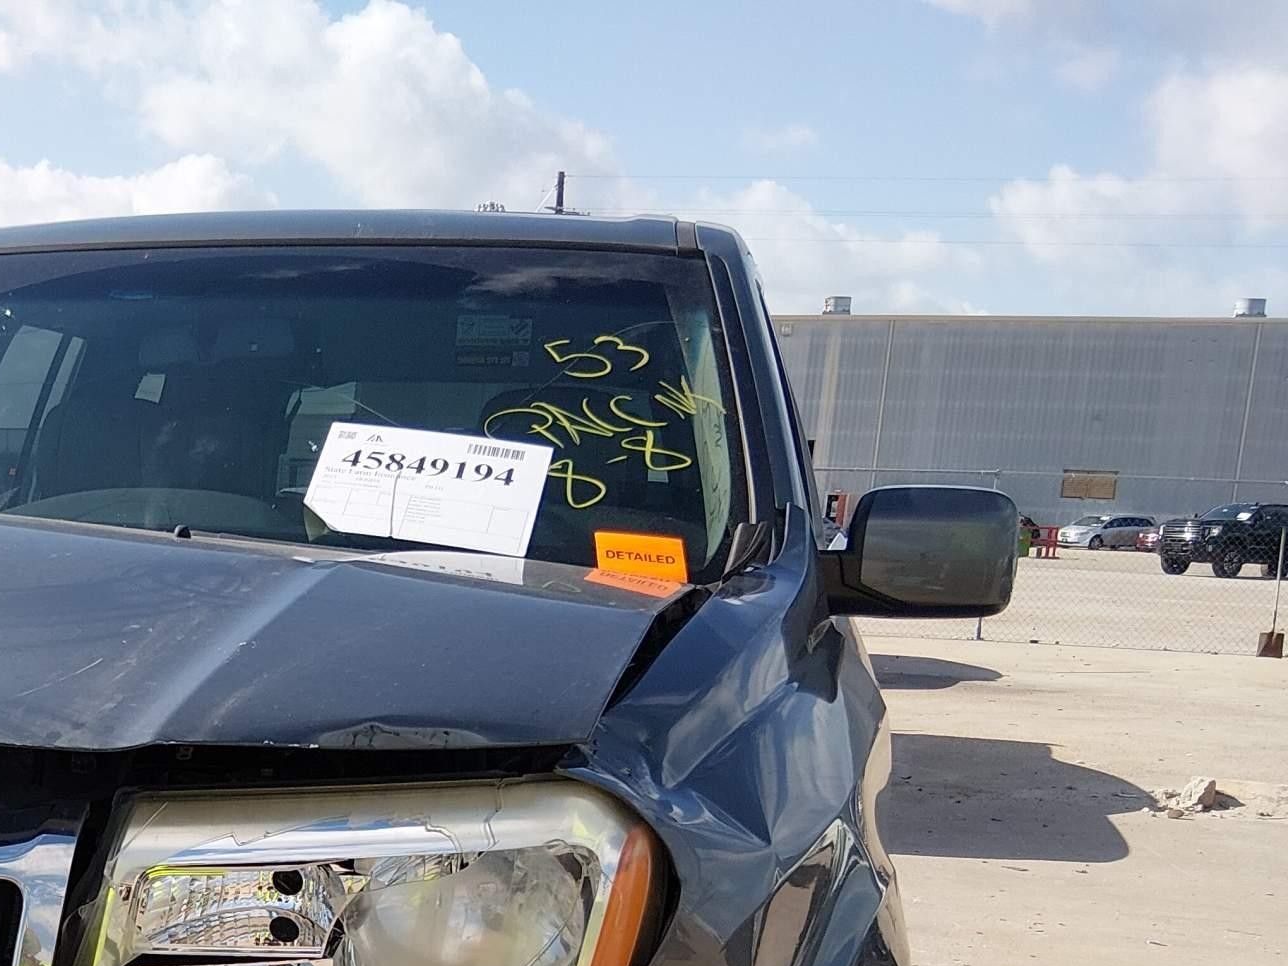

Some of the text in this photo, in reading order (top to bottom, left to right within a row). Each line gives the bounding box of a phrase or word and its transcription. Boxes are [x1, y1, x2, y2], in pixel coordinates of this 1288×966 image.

[544, 335, 650, 378] 53
[341, 449, 515, 487] 45849194
[605, 550, 676, 565] DETAILED
